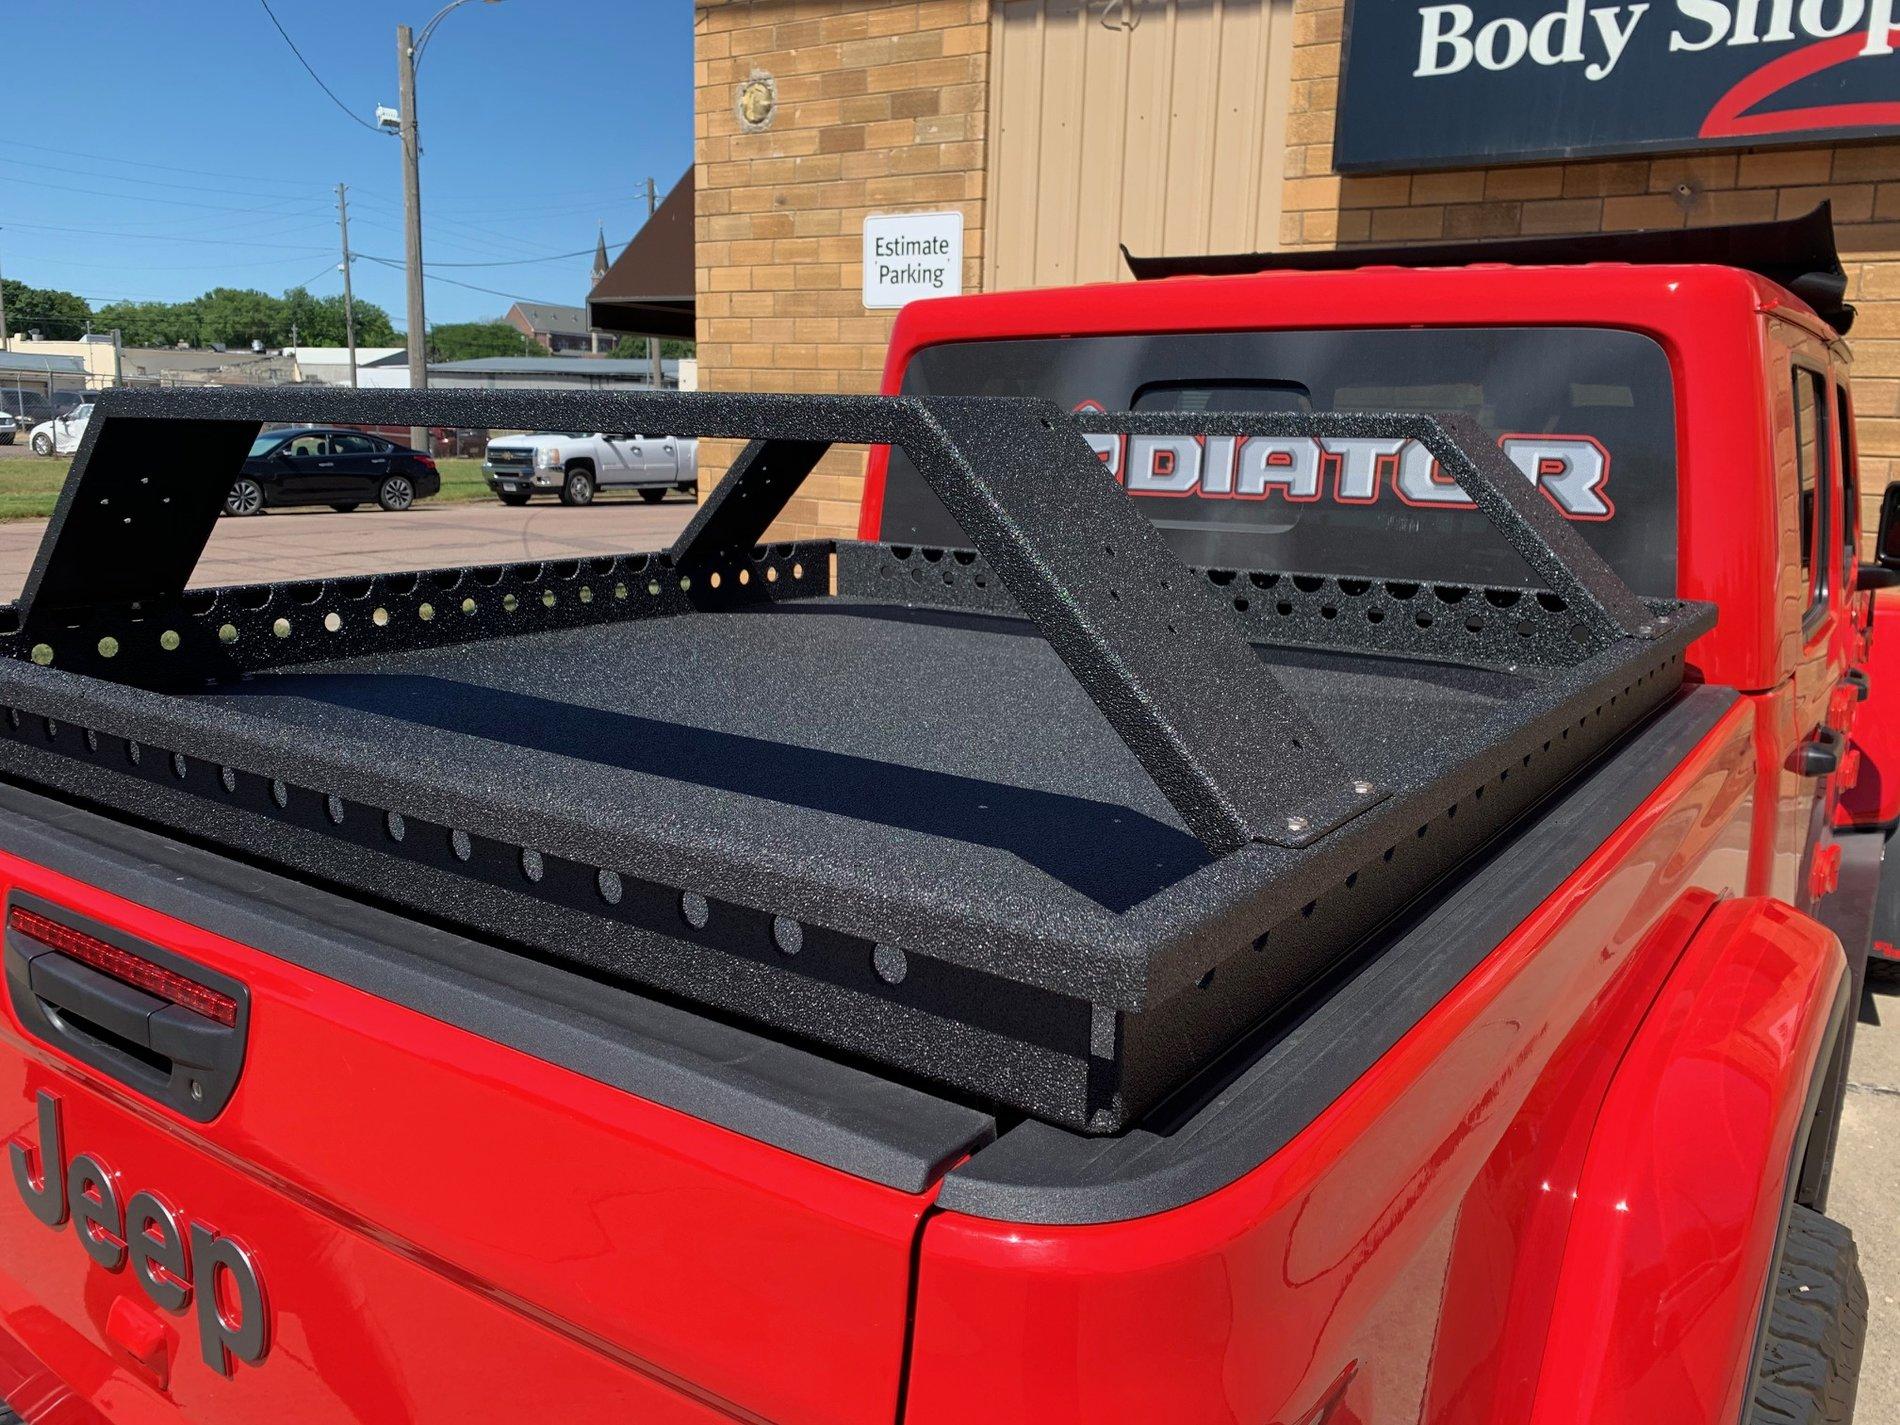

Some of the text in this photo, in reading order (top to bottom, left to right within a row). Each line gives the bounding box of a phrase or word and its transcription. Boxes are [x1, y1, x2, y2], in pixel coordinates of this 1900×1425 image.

[1413, 0, 1650, 81] Body
[875, 235, 949, 257] Estimate
[879, 263, 944, 288] Parking
[9, 1090, 272, 1378] Jeep
